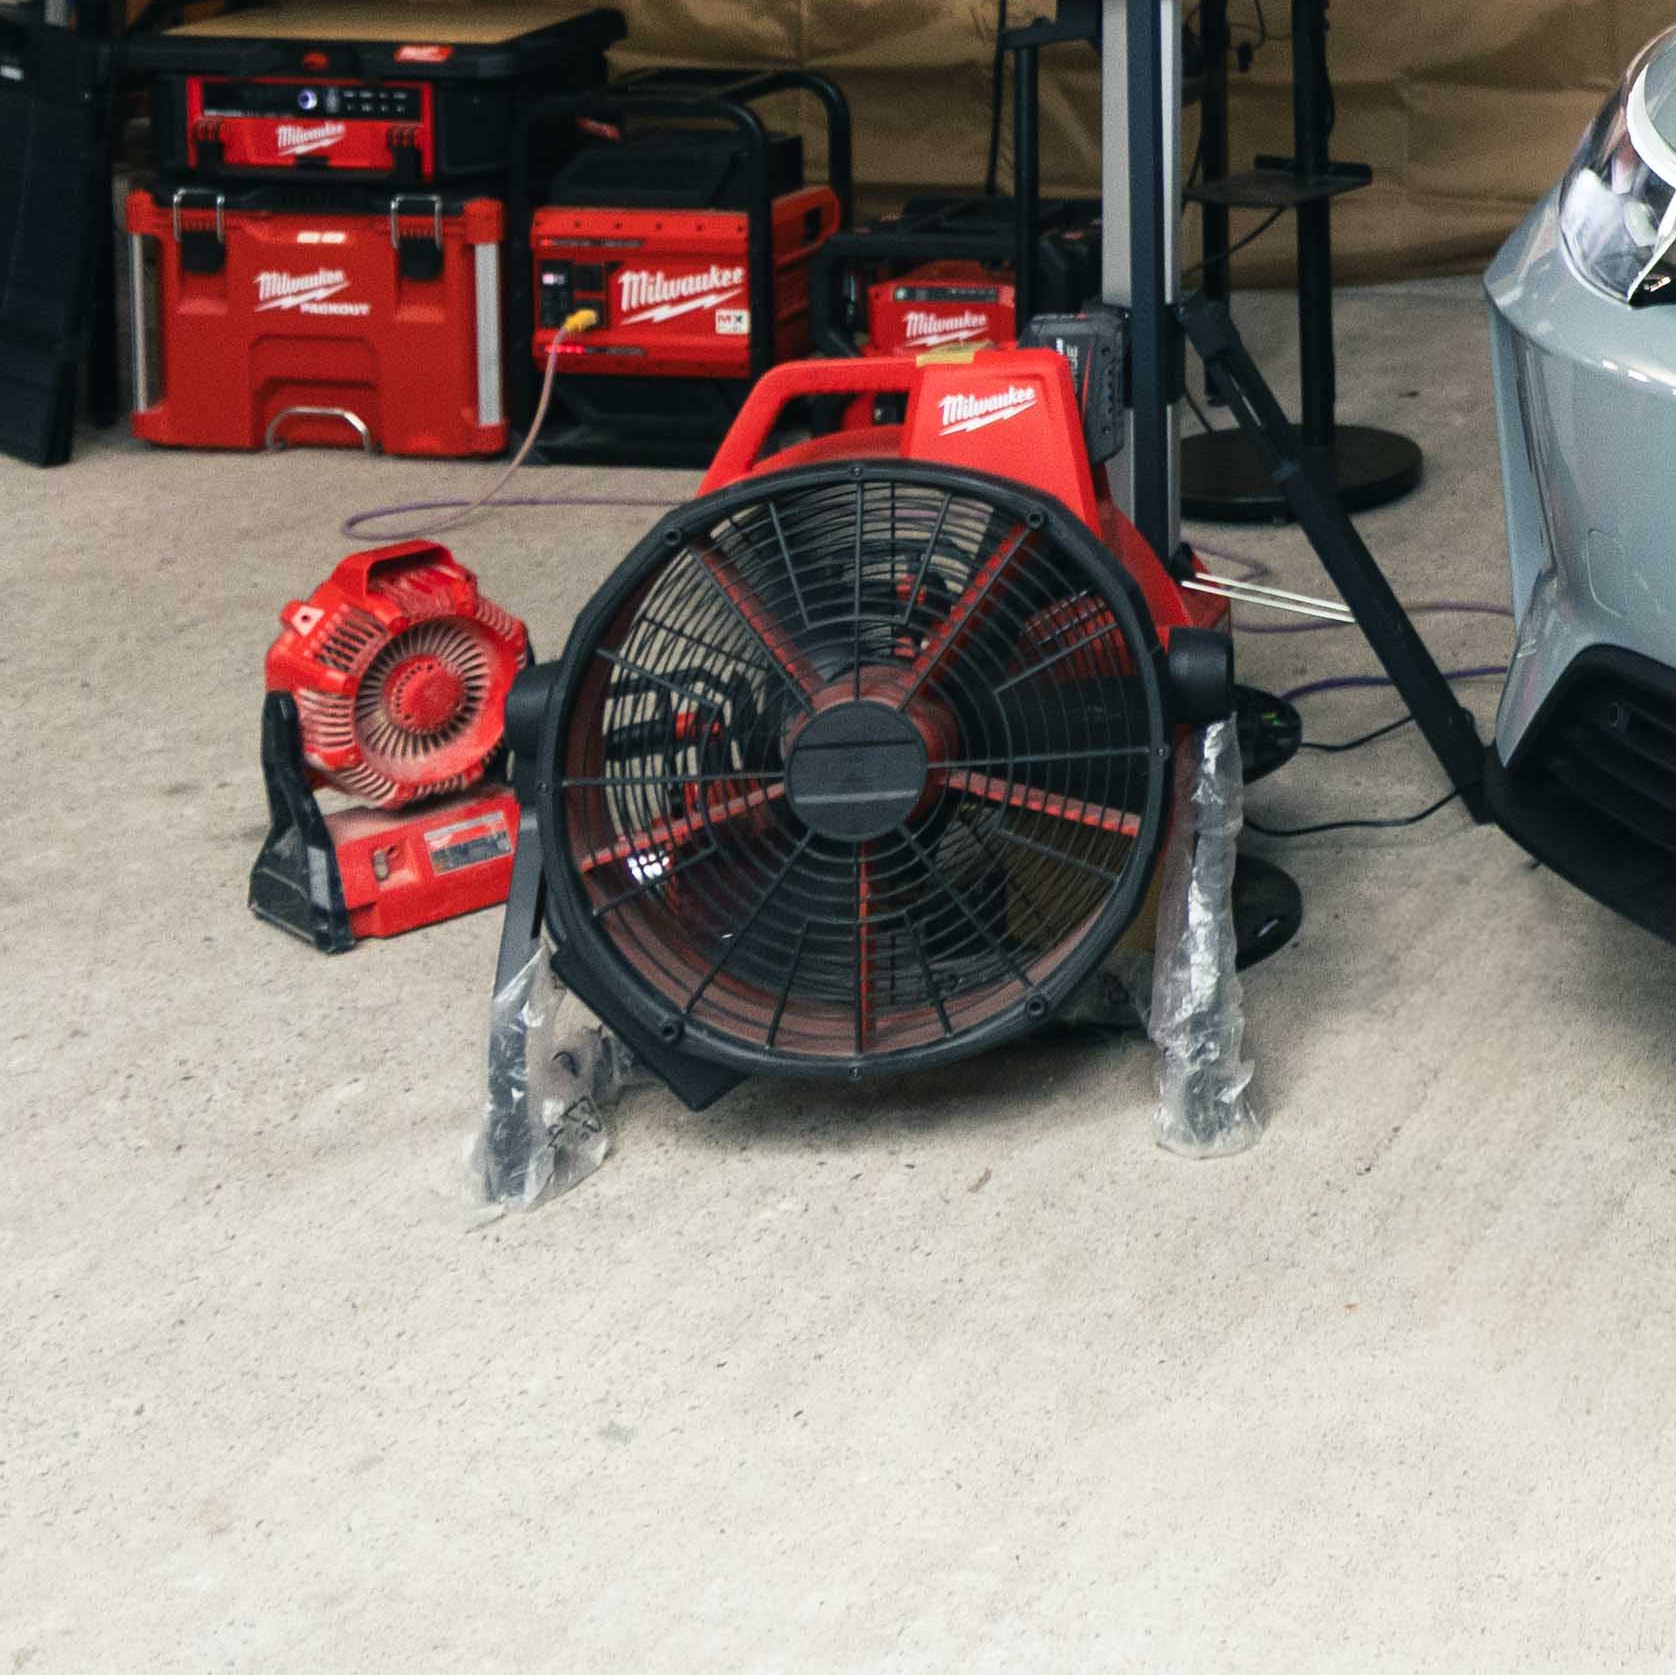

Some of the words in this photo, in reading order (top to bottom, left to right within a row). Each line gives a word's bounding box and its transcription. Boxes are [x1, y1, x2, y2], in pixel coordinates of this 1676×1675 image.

[618, 265, 744, 312] Milwaukee
[904, 310, 988, 338] Milwaukee
[938, 385, 1036, 426] Milwaukee
